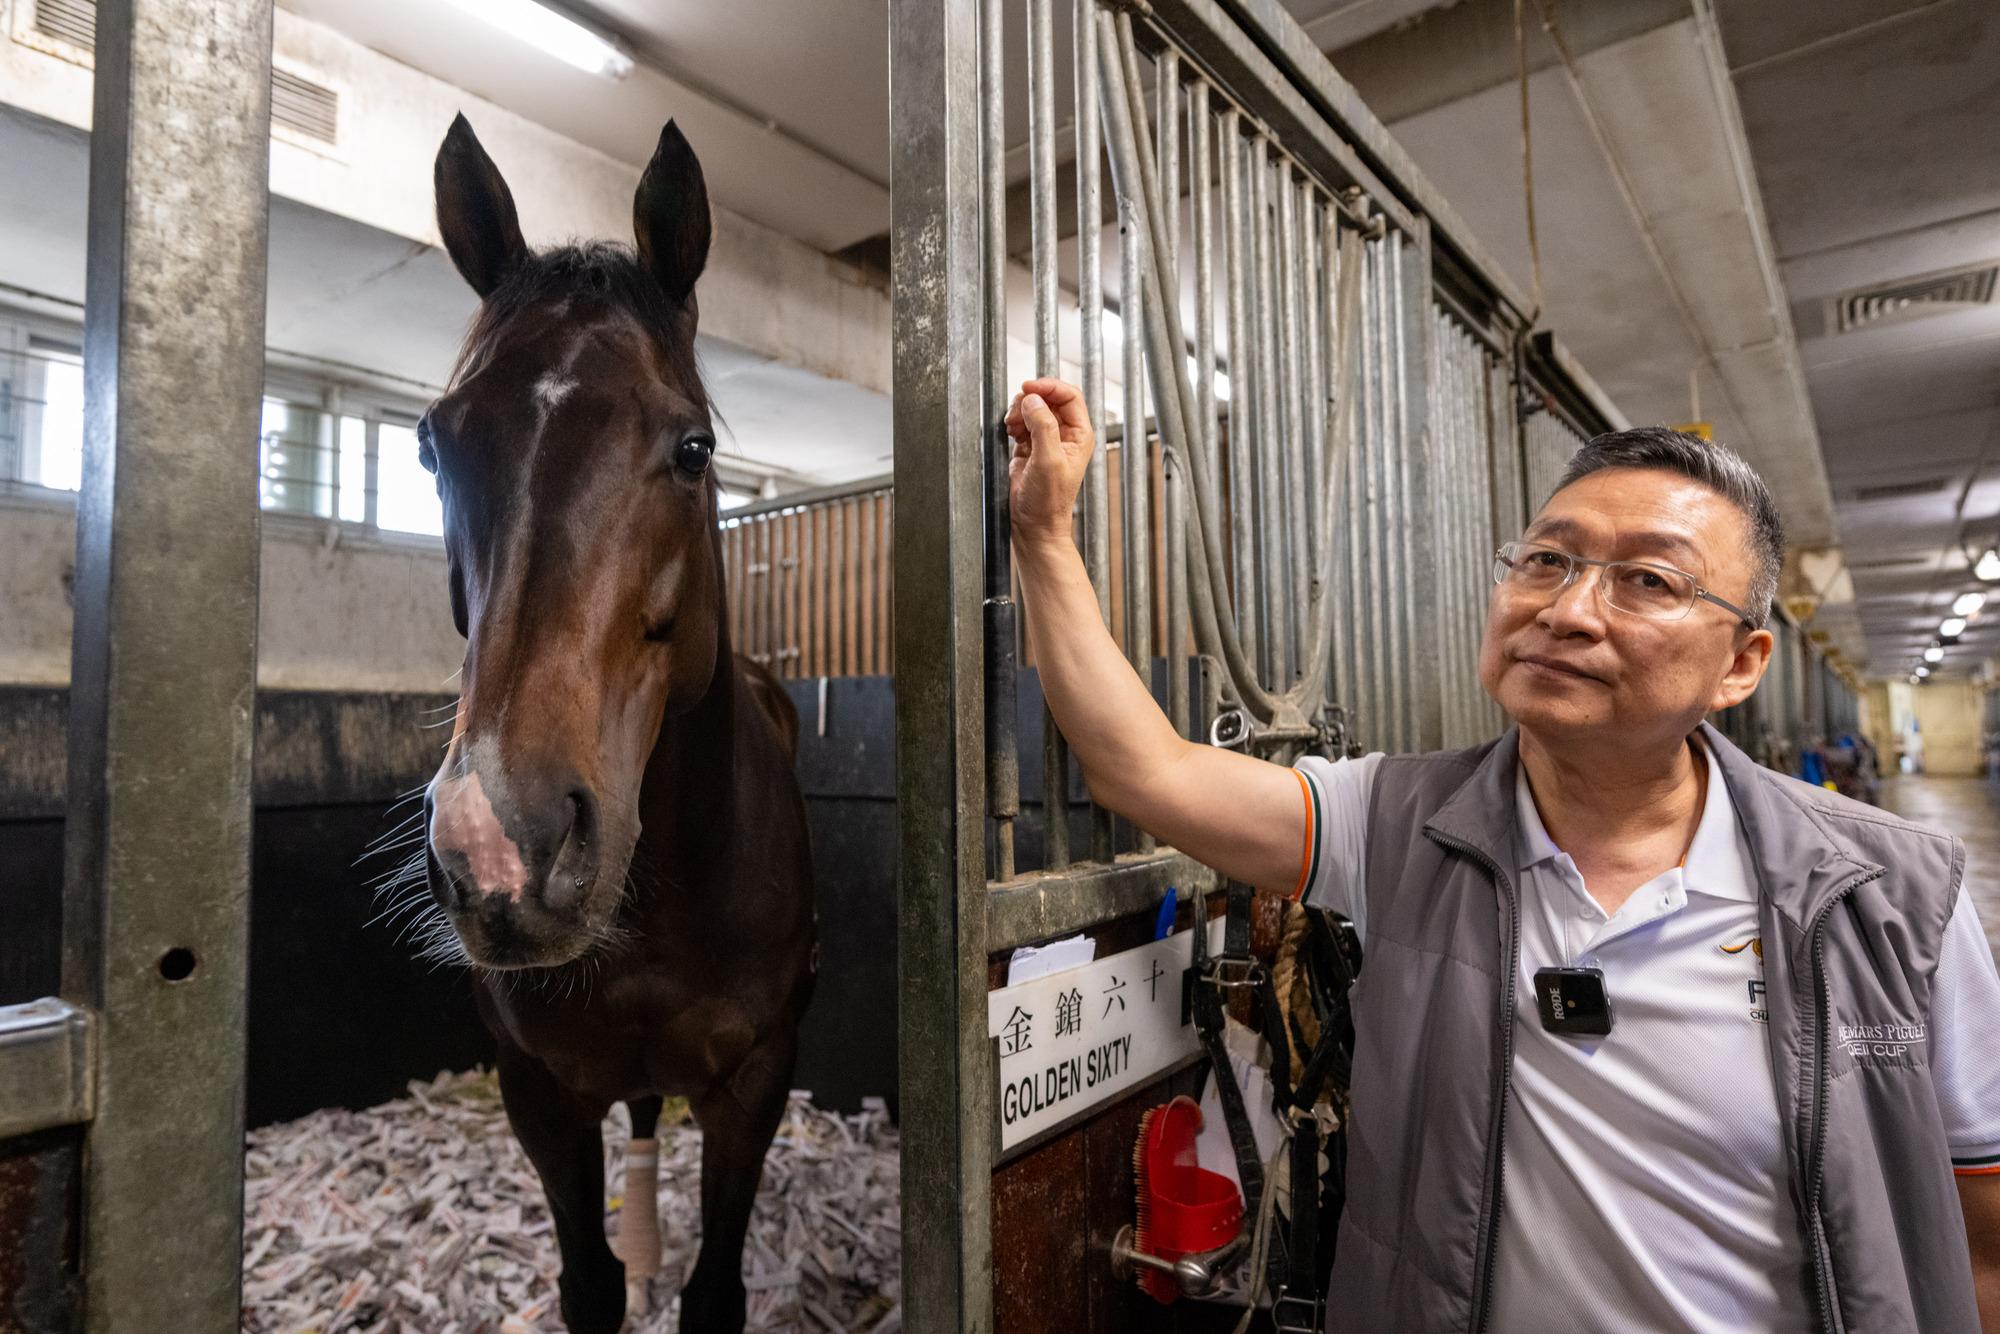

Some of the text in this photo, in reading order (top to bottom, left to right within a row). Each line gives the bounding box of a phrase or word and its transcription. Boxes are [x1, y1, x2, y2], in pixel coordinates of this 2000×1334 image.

[1001, 959, 1165, 1059] 金鎗六十
[1847, 1043, 1907, 1057] QEII CUP
[1003, 1033, 1132, 1126] GOLDEN SIXTY
